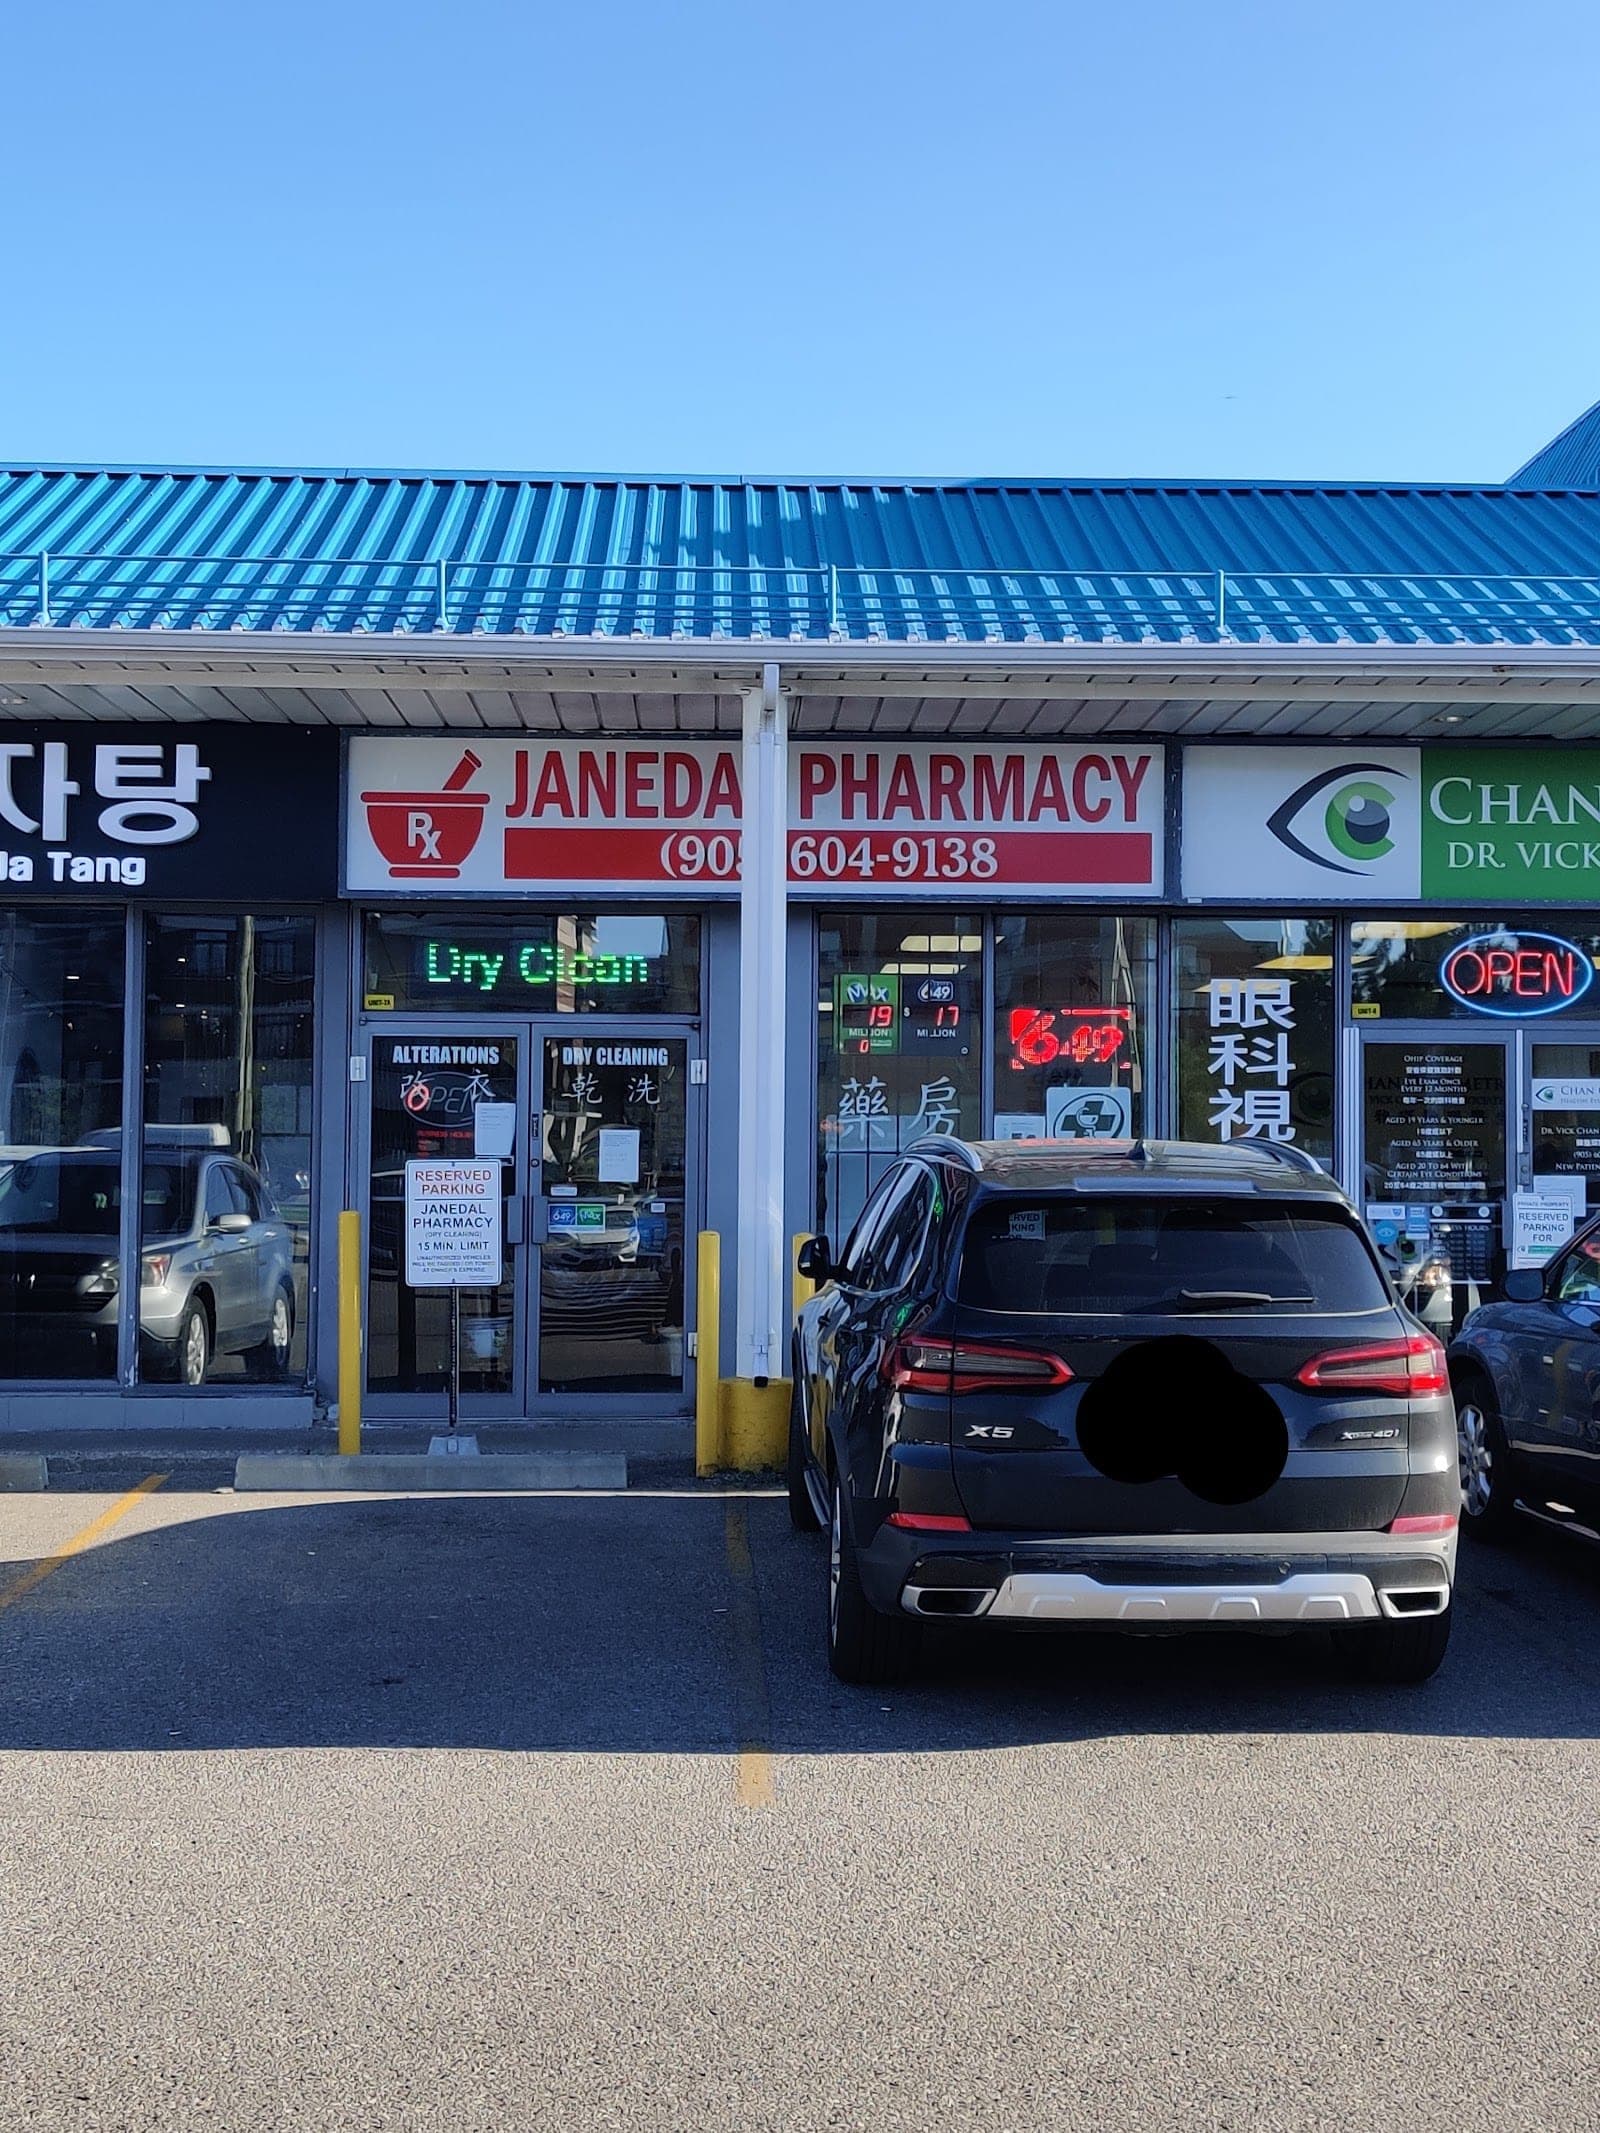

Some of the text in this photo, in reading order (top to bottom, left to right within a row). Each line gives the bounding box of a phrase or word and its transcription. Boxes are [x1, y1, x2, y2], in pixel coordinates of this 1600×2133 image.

[505, 750, 1152, 823] JANEDA PHARMACY
[660, 832, 999, 879] (90 604-9138
[1514, 841, 1600, 870] VICK
[47, 851, 146, 886] Tang
[428, 943, 648, 991] Dry Clean
[1449, 950, 1574, 996] OPEN
[870, 1006, 892, 1027] 19
[936, 1006, 960, 1027] 17
[392, 1045, 501, 1065] ALTERATIONS
[562, 1046, 669, 1066] DRY CLEANING
[415, 1170, 492, 1182] RESERVED
[421, 1184, 485, 1195] PARKING
[420, 1203, 487, 1215] JANEDAL
[1518, 1212, 1569, 1222] RESERVED
[413, 1217, 494, 1229] PHARMACY
[1523, 1223, 1565, 1232] PARKING
[417, 1241, 430, 1251] 15
[460, 1241, 489, 1251] LIMIT
[1532, 1233, 1552, 1242] FOR
[964, 1424, 1015, 1439] X5
